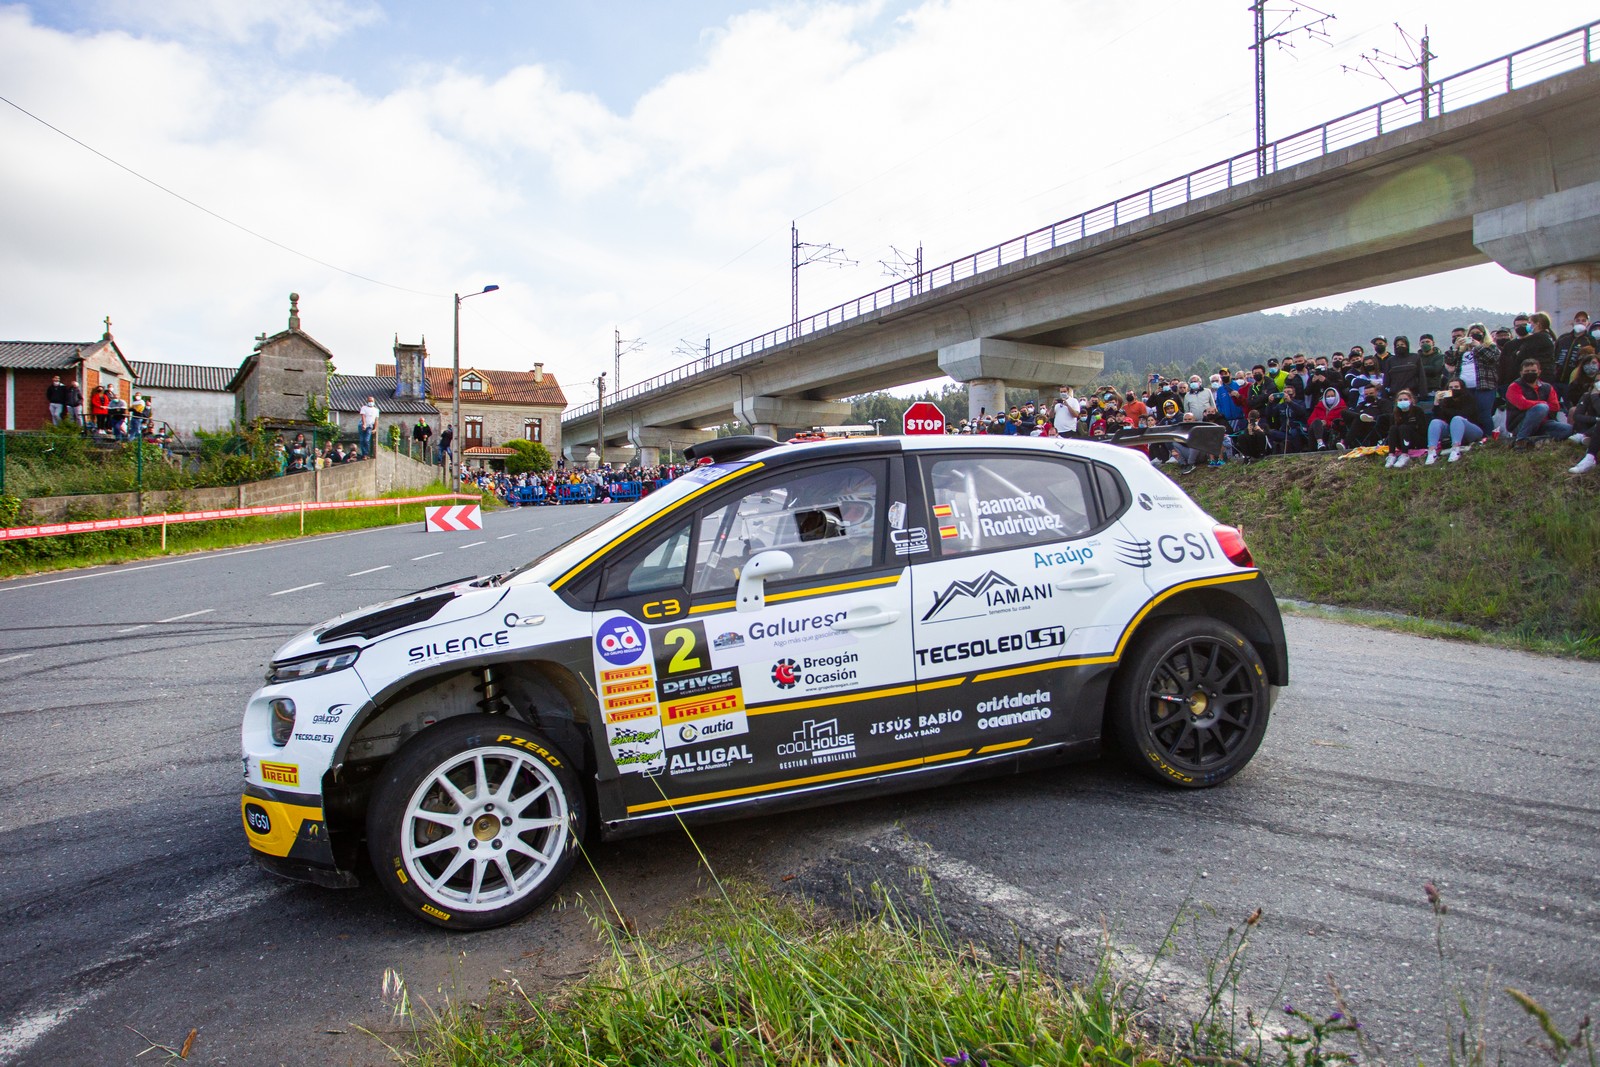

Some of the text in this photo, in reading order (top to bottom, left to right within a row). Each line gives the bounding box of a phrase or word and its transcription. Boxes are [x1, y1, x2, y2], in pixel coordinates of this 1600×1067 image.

[907, 418, 942, 430] STOP
[951, 492, 1046, 518] I. Caamaño
[980, 514, 1064, 537] Rodriguez
[890, 527, 927, 544] C3
[1157, 532, 1214, 563] GSI
[1034, 546, 1093, 569] Araújo
[642, 599, 681, 619] C3
[748, 610, 847, 640] Galuresa
[408, 629, 510, 662] SILENCE
[663, 627, 701, 674] 2
[773, 640, 788, 648] Algo
[787, 637, 802, 645] más
[801, 634, 815, 643] que
[915, 627, 1065, 666] TECSOLED LST
[803, 651, 859, 669] Breogán
[604, 666, 648, 681] PIRELLI
[804, 669, 857, 685] Ocasión
[606, 679, 650, 694] PIRELLI
[608, 693, 652, 708] PIRELLI
[668, 695, 737, 720] PIRELLI
[610, 707, 653, 722] PIRELLI
[977, 706, 1052, 730] caamaño
[701, 719, 734, 735] autia
[869, 716, 912, 735] JESÚS
[894, 732, 914, 741] CASA
[920, 727, 941, 736] BAÑO
[295, 733, 322, 741] TECSOLED
[777, 733, 855, 755] COOLHOUSE
[670, 744, 753, 770] ALUGAL
[779, 751, 856, 770] GESTIÓN INMOBILIARIA
[261, 763, 298, 784] PIRELLI
[670, 768, 694, 776] Sistemas
[705, 762, 728, 770] Aluminio
[255, 813, 270, 831] GSI
